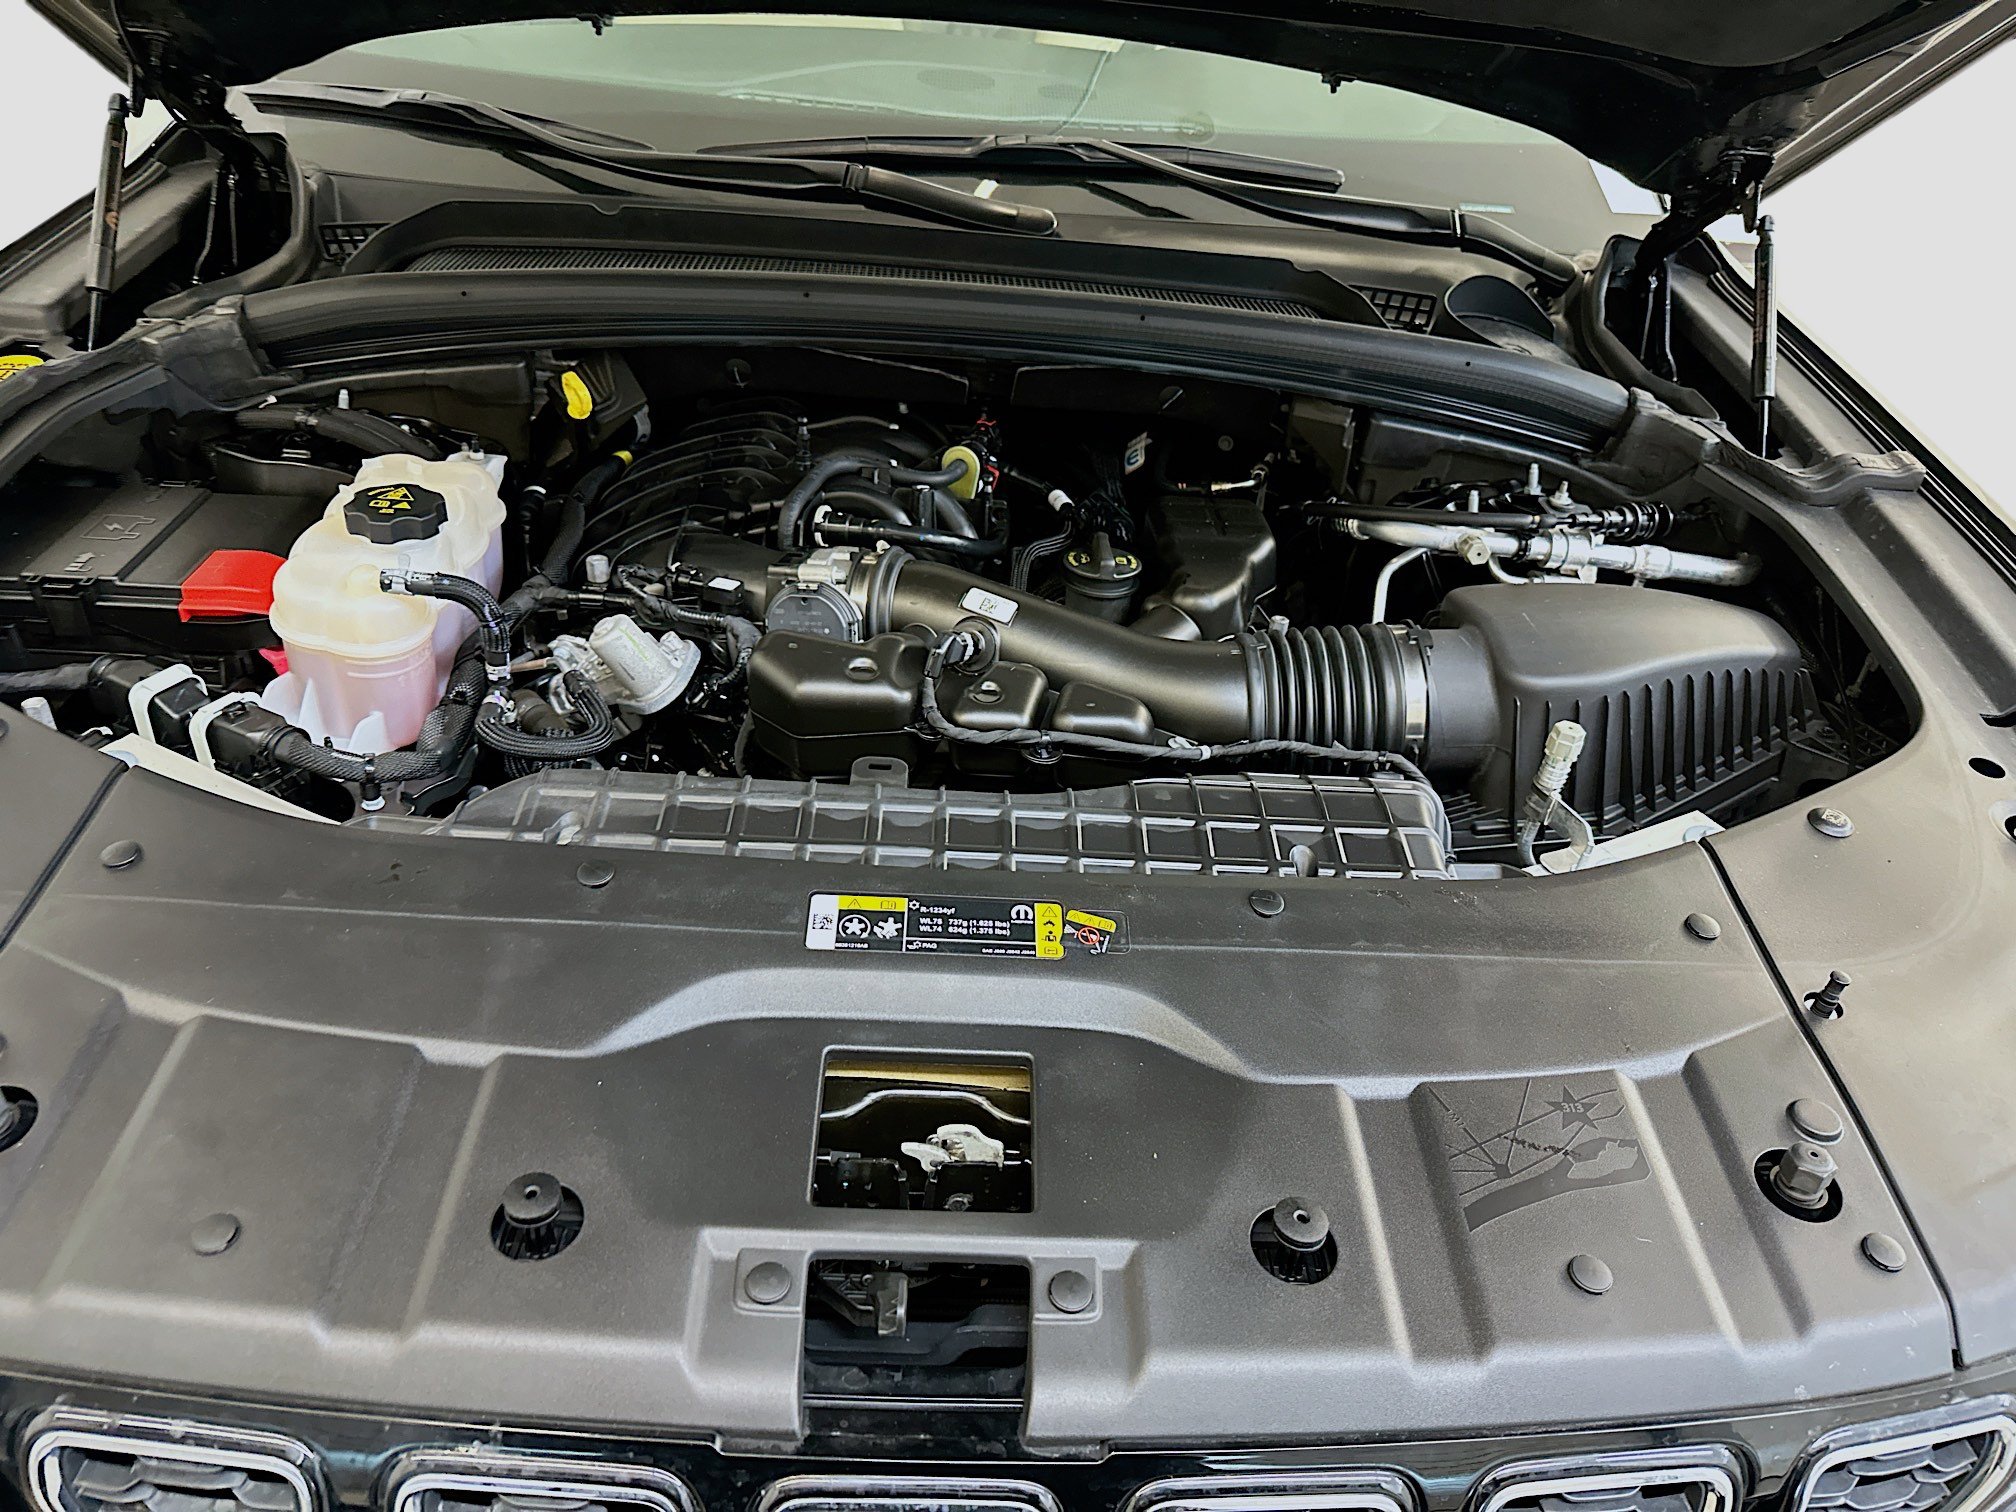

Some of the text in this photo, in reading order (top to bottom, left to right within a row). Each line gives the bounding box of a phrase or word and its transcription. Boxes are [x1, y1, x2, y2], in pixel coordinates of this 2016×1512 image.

[920, 906, 956, 915] R-1234yf
[947, 918, 968, 927] 737g
[994, 920, 1010, 929] lbs)
[919, 925, 943, 933] WL74
[994, 928, 1010, 937] lbs)
[1560, 1102, 1585, 1113] 313
